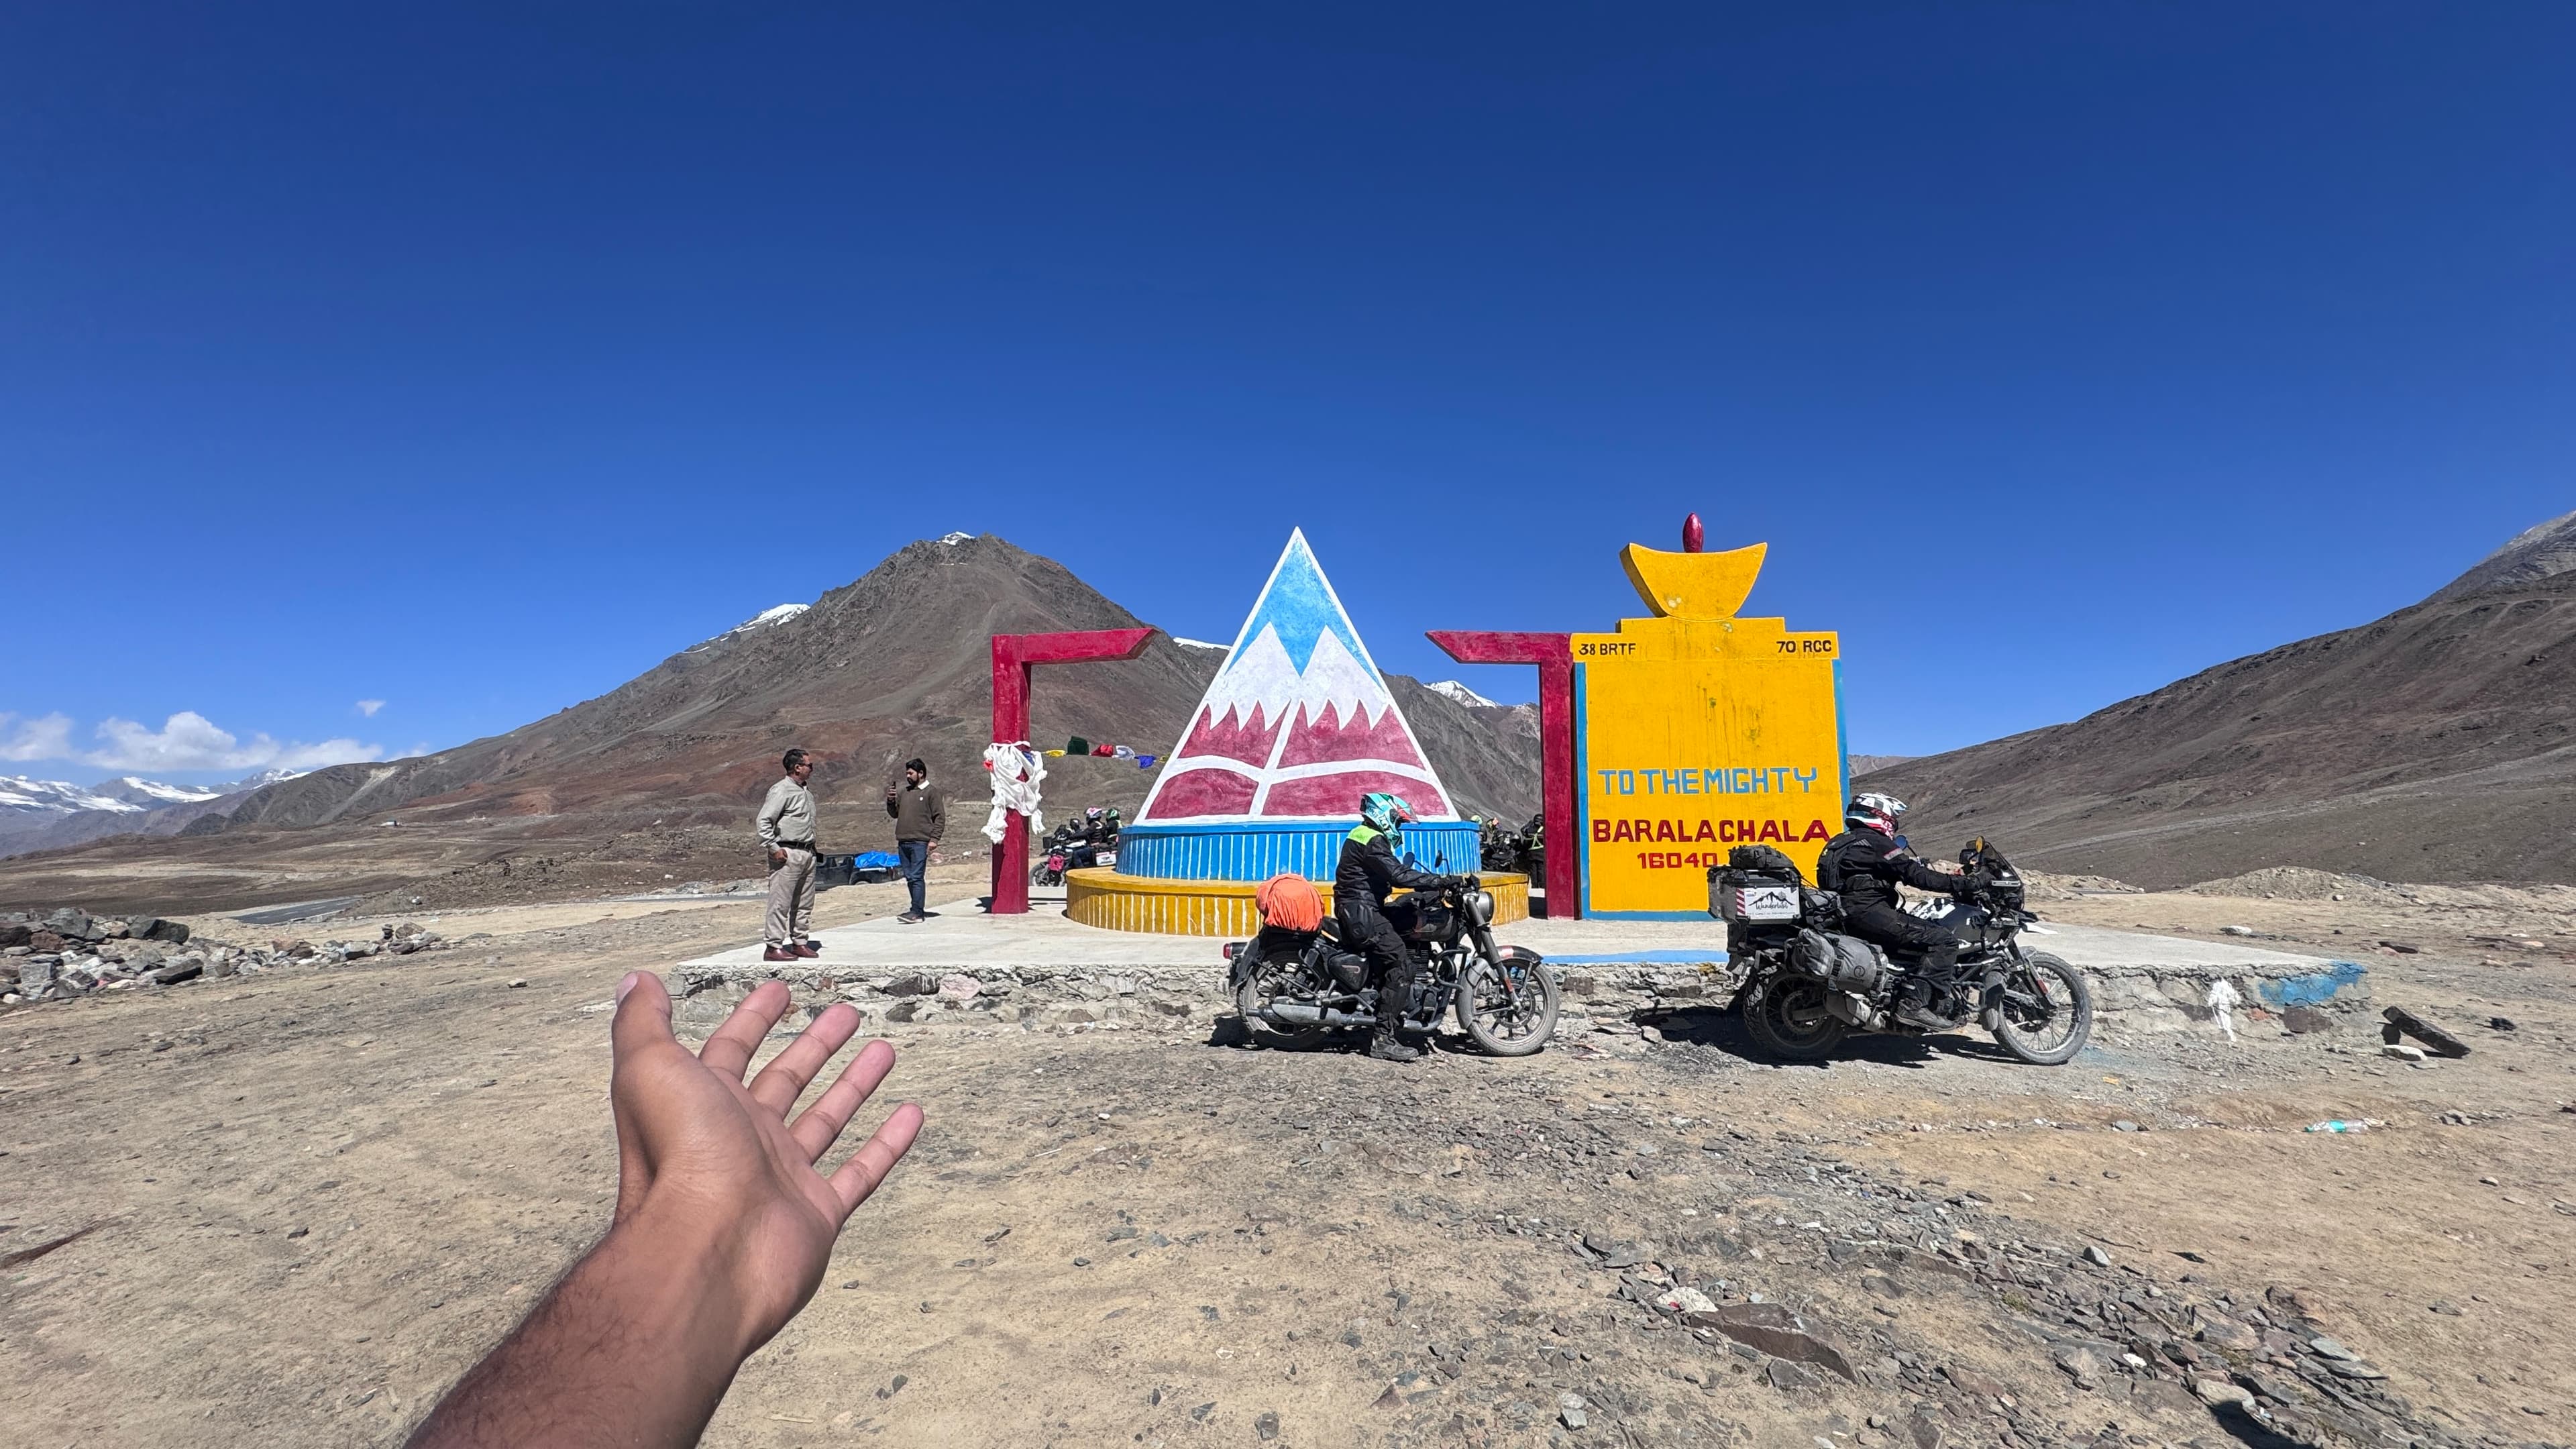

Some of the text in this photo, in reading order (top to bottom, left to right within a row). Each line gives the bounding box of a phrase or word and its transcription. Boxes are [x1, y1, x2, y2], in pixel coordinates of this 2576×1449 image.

[1578, 643, 1636, 655] 38 BRTF
[1776, 640, 1832, 653] 70 RCC
[1597, 766, 1817, 796] TO THE MIGHTY
[1593, 819, 1831, 843] BARALACHALA
[1637, 852, 1718, 869] 16040
